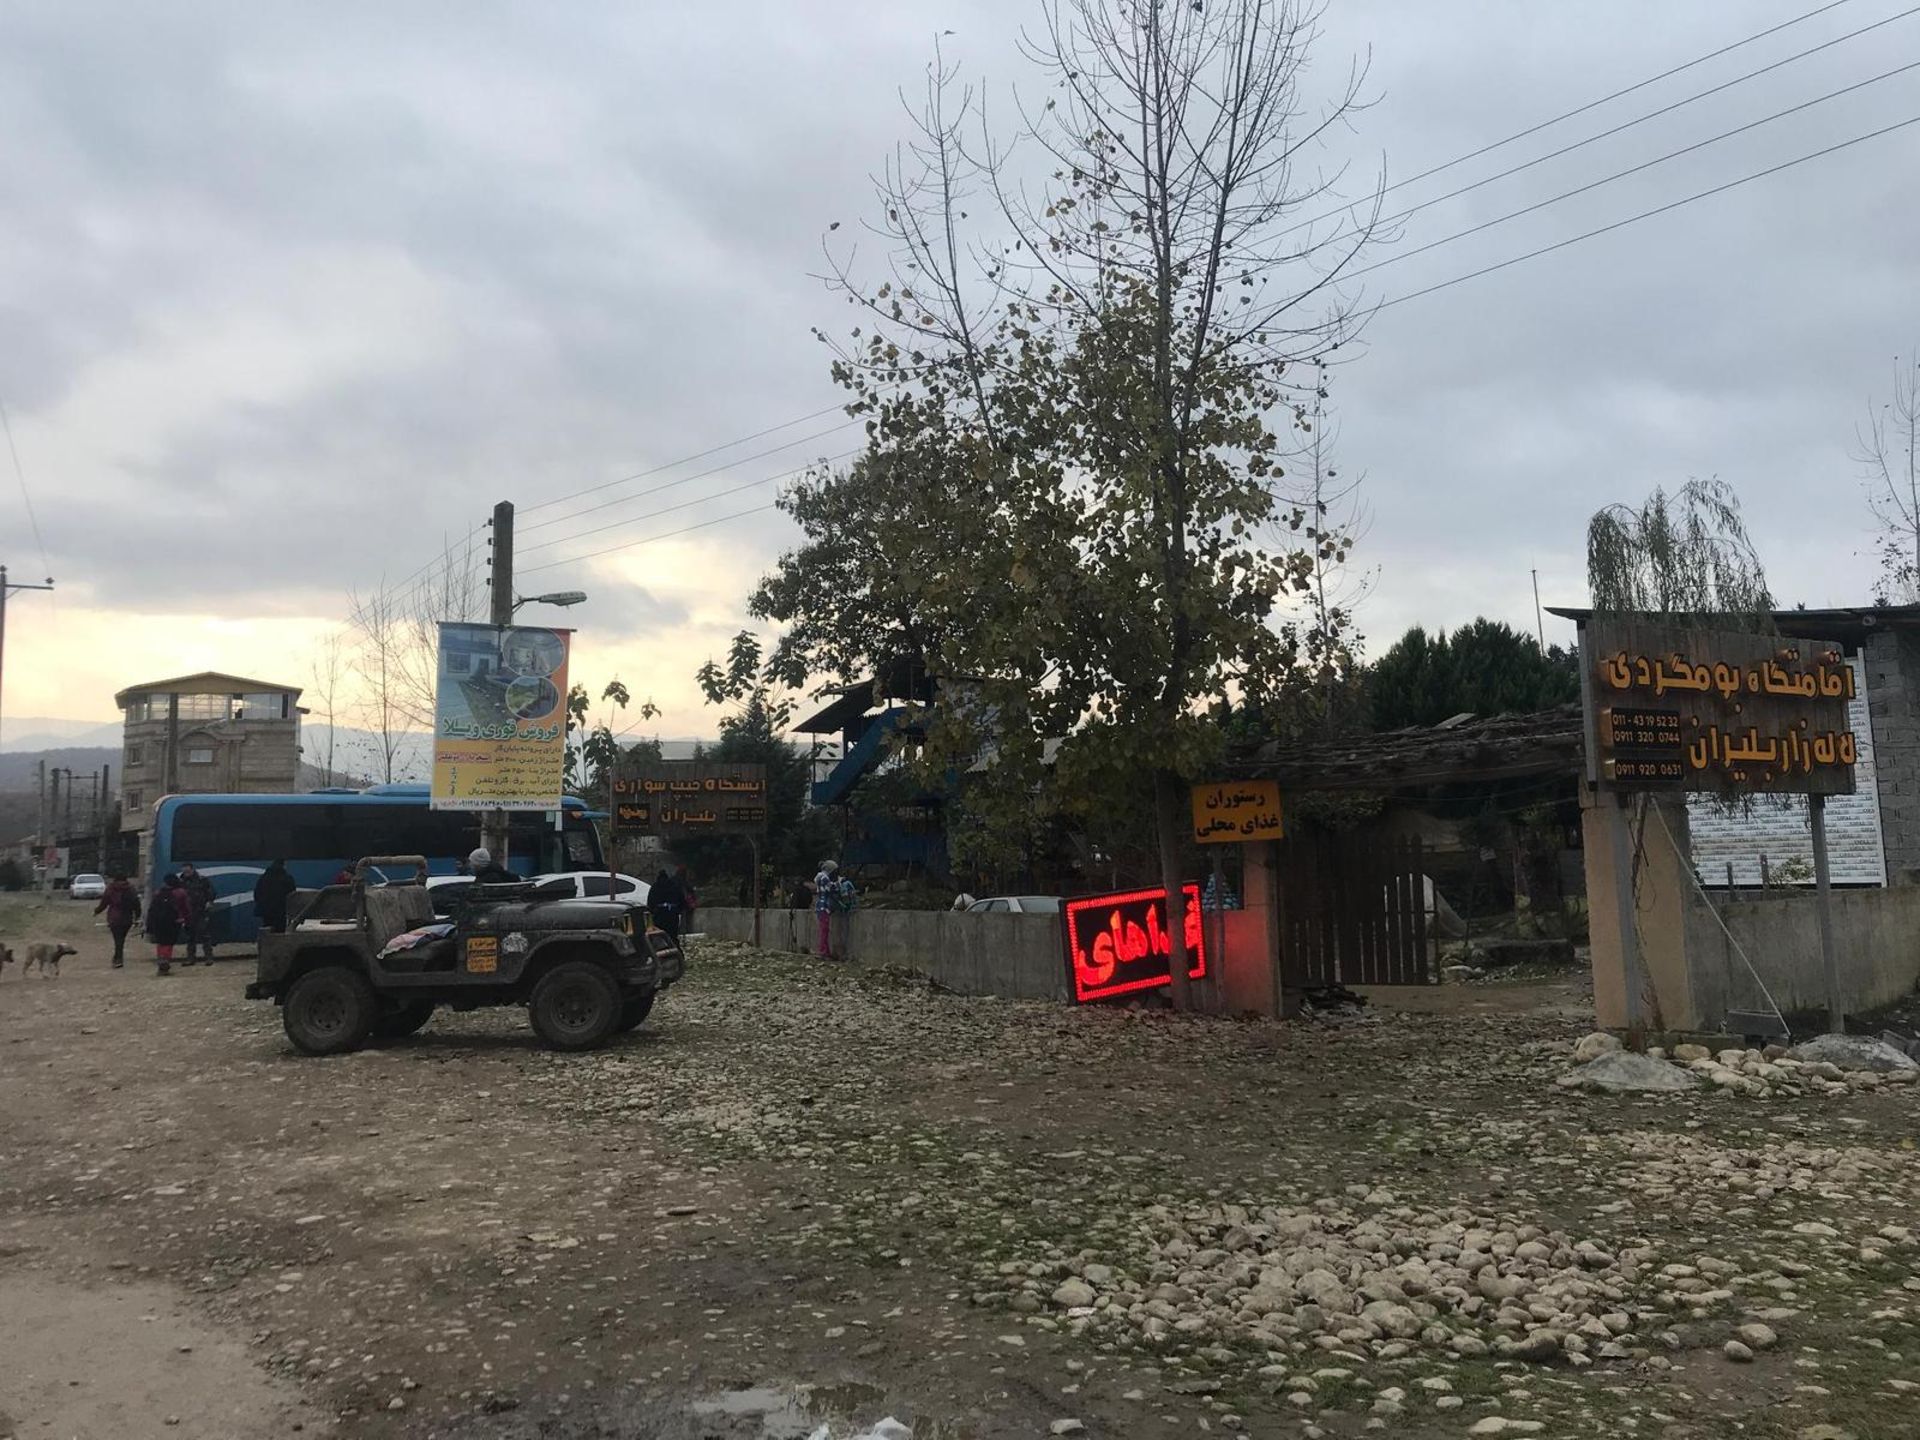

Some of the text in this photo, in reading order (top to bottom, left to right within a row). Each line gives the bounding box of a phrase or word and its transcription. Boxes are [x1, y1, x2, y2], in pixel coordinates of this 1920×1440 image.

[1748, 650, 1856, 699] اقامتگاه
[520, 721, 560, 743] فروش
[1689, 715, 1777, 781] بلیران
[614, 778, 666, 793] سواری
[705, 774, 767, 798] ایستگاه
[1206, 789, 1266, 809] رستوران
[661, 804, 717, 830] بلیران
[1196, 813, 1279, 837] غذای محلی
